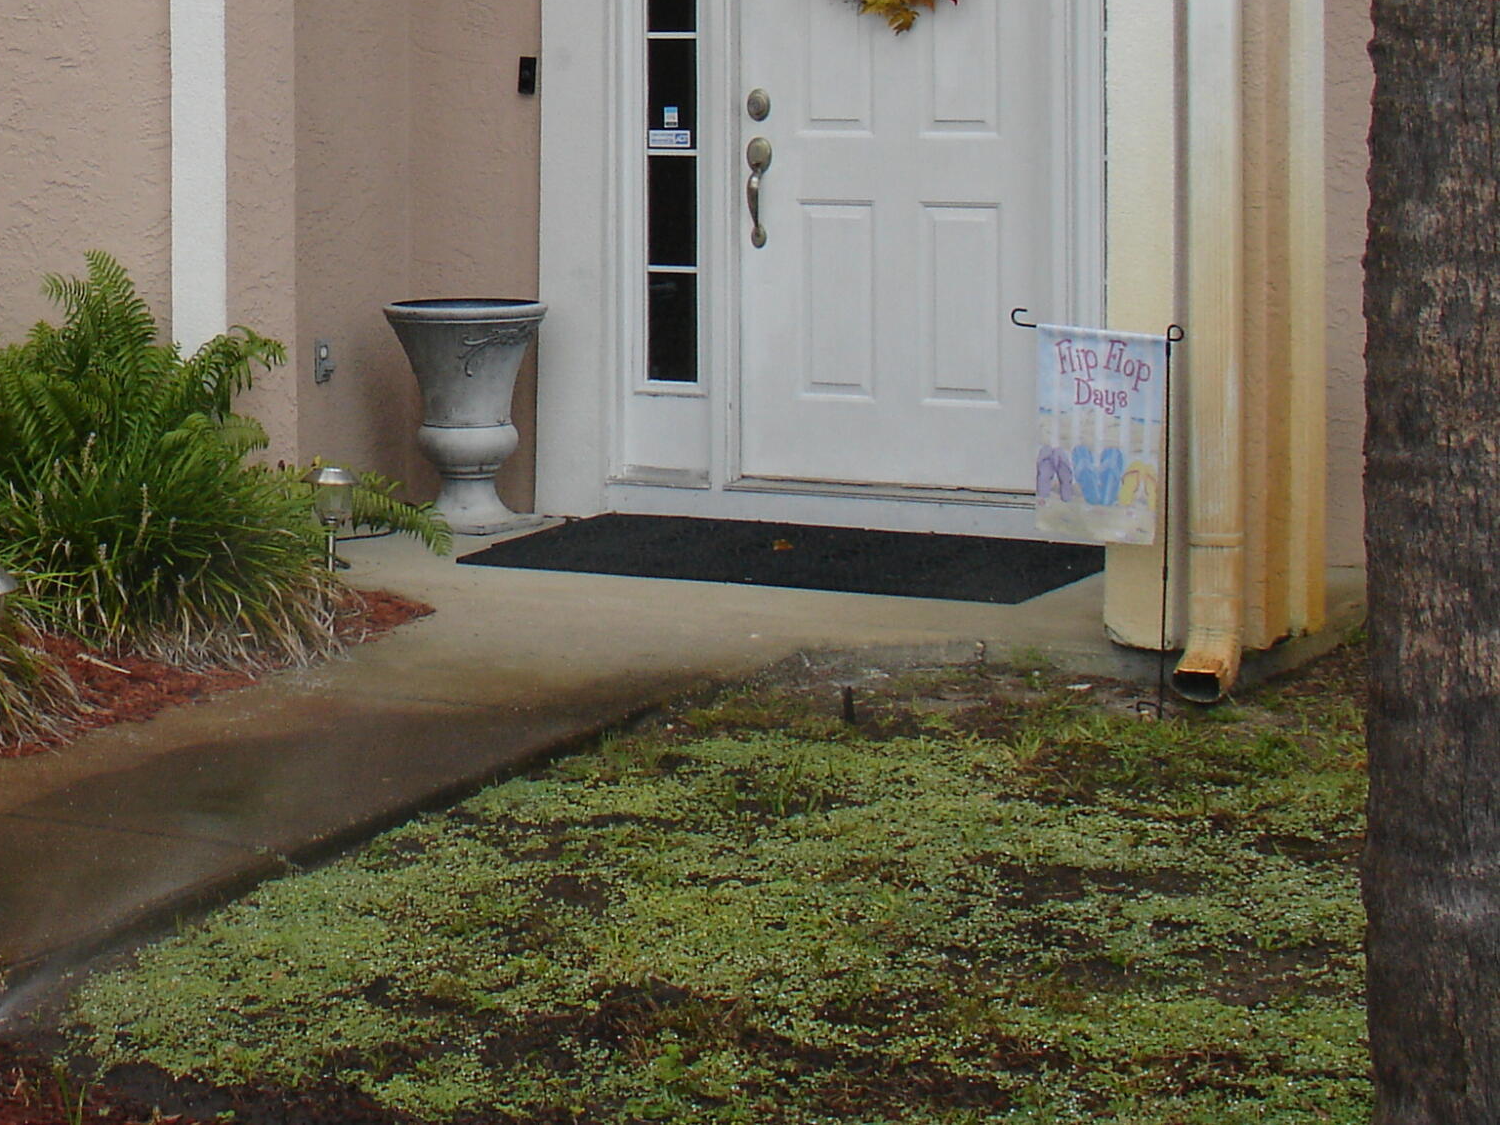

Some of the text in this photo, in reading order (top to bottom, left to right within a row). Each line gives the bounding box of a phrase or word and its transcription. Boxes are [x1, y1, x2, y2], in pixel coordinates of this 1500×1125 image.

[1055, 338, 1151, 392] Flip Flop
[1074, 377, 1128, 415] Days
